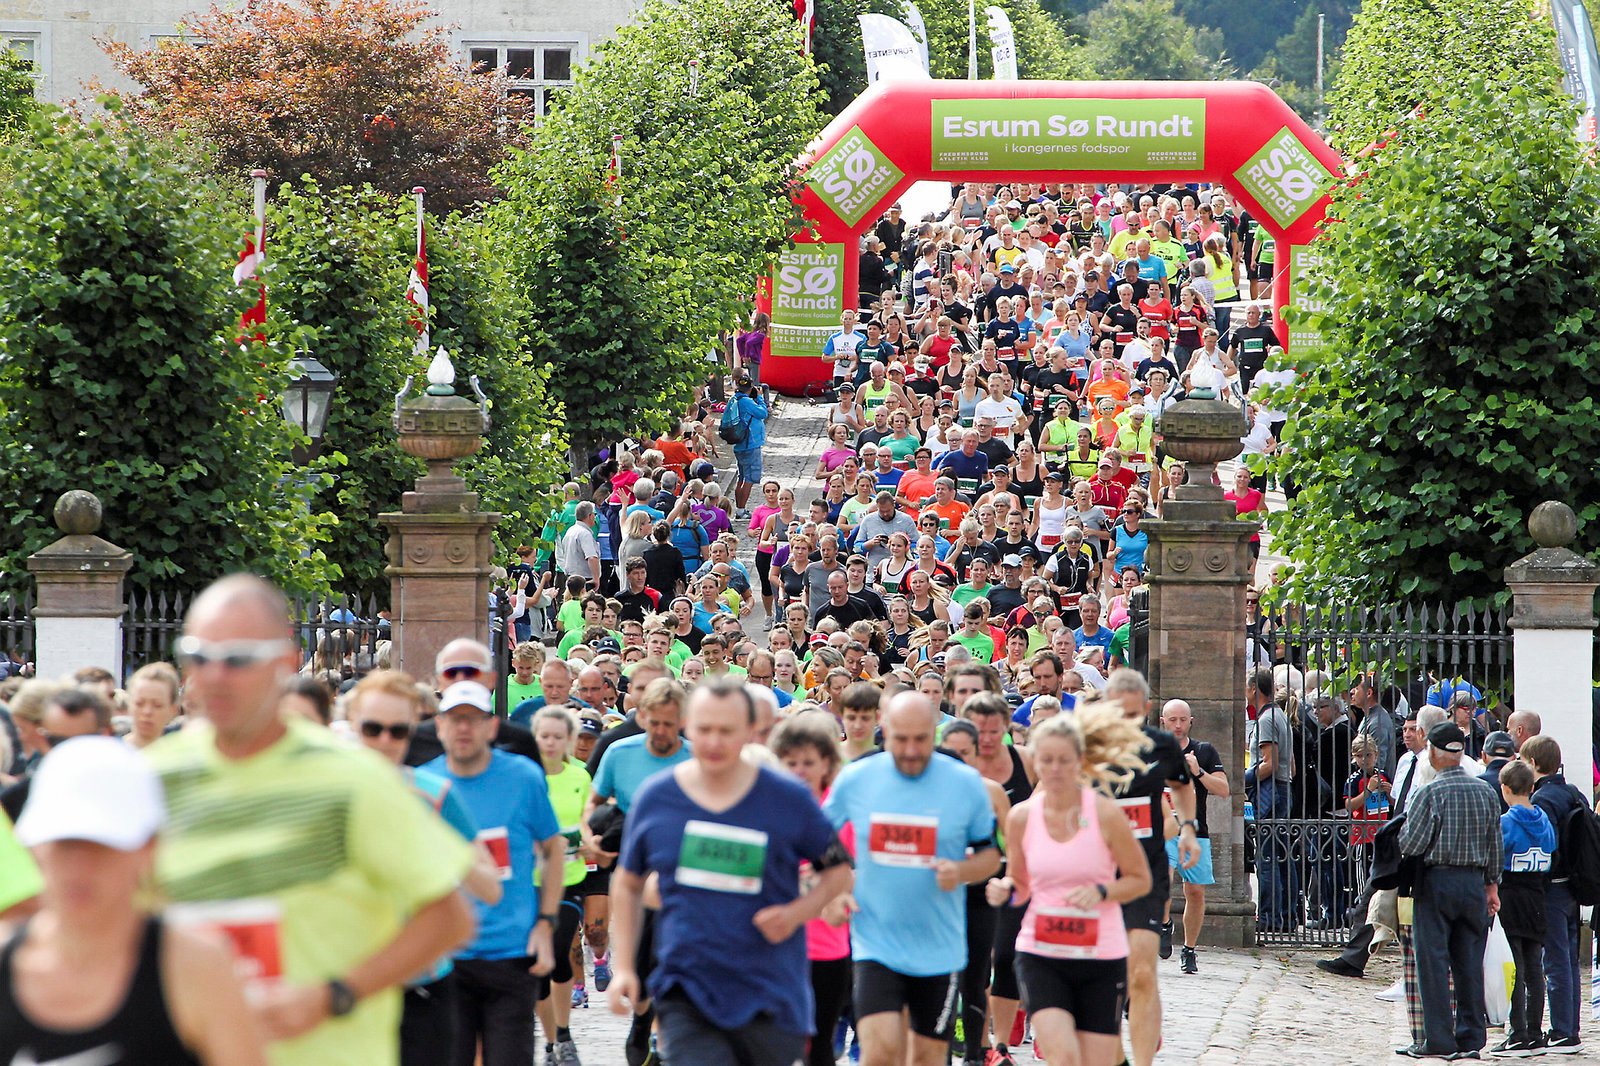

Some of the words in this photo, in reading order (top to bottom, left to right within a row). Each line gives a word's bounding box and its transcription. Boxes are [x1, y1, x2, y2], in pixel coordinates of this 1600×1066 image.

[943, 115, 1040, 138] Esrum
[1047, 114, 1089, 137] Sø
[1096, 114, 1193, 137] Rundt
[809, 135, 862, 183] Esrum
[1005, 143, 1008, 152] i
[1012, 143, 1078, 154] kongernes
[1082, 143, 1130, 154] fodspor
[839, 165, 892, 215] Rundt
[1246, 164, 1297, 217] Rundt
[777, 294, 837, 310] Rundt
[880, 825, 922, 842] 3361
[1044, 916, 1086, 936] 3448
